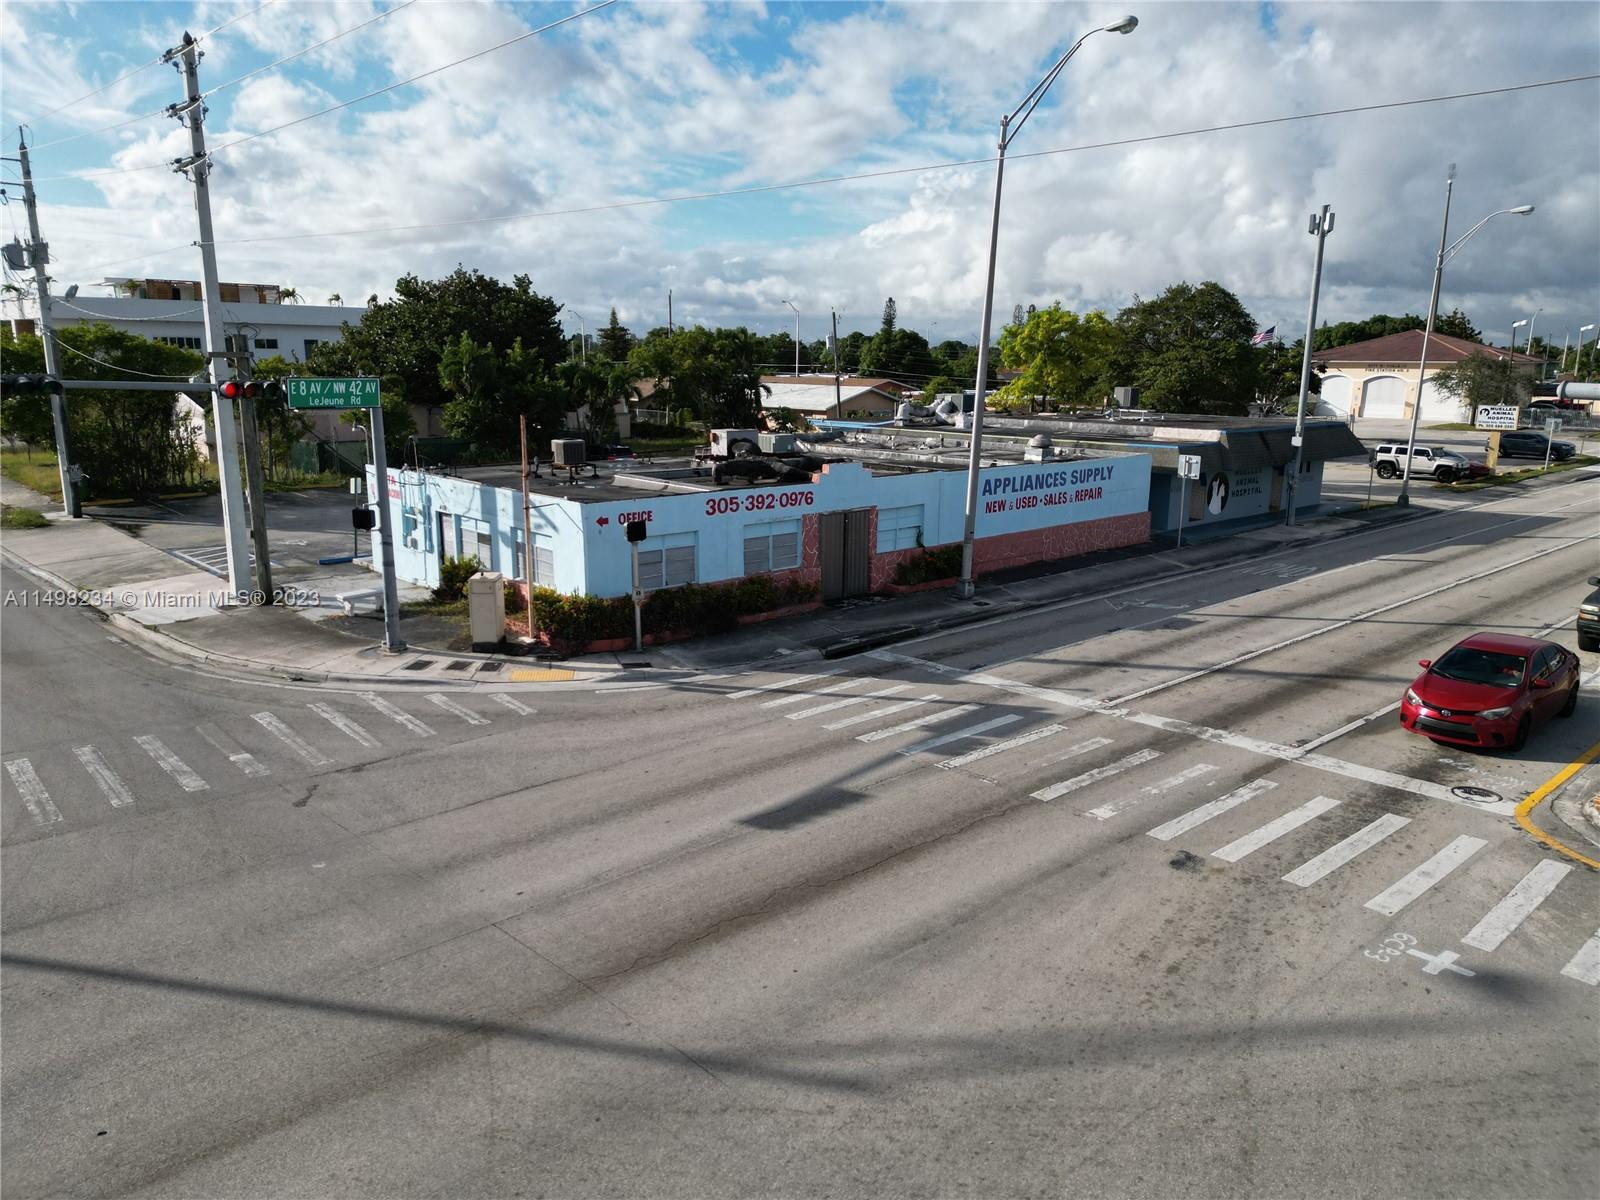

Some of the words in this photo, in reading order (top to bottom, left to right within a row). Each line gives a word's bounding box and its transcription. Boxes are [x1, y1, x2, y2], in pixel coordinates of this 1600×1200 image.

[291, 382, 296, 394] E
[300, 381, 306, 395] 8
[310, 382, 321, 394] AV
[333, 382, 346, 393] NW
[349, 381, 362, 395] 42
[365, 382, 376, 393] AV
[309, 396, 344, 406] LeJeune
[351, 396, 361, 405] Rd
[982, 471, 1067, 496] APPLIANCES
[1070, 466, 1114, 485] SUPPLY
[1231, 487, 1262, 497] HOSPITAL
[985, 500, 1007, 513] NEW
[1016, 495, 1037, 509] USED
[1043, 492, 1067, 506] SALES
[1074, 487, 1103, 502] REPAIR
[618, 510, 653, 525] OFFICE
